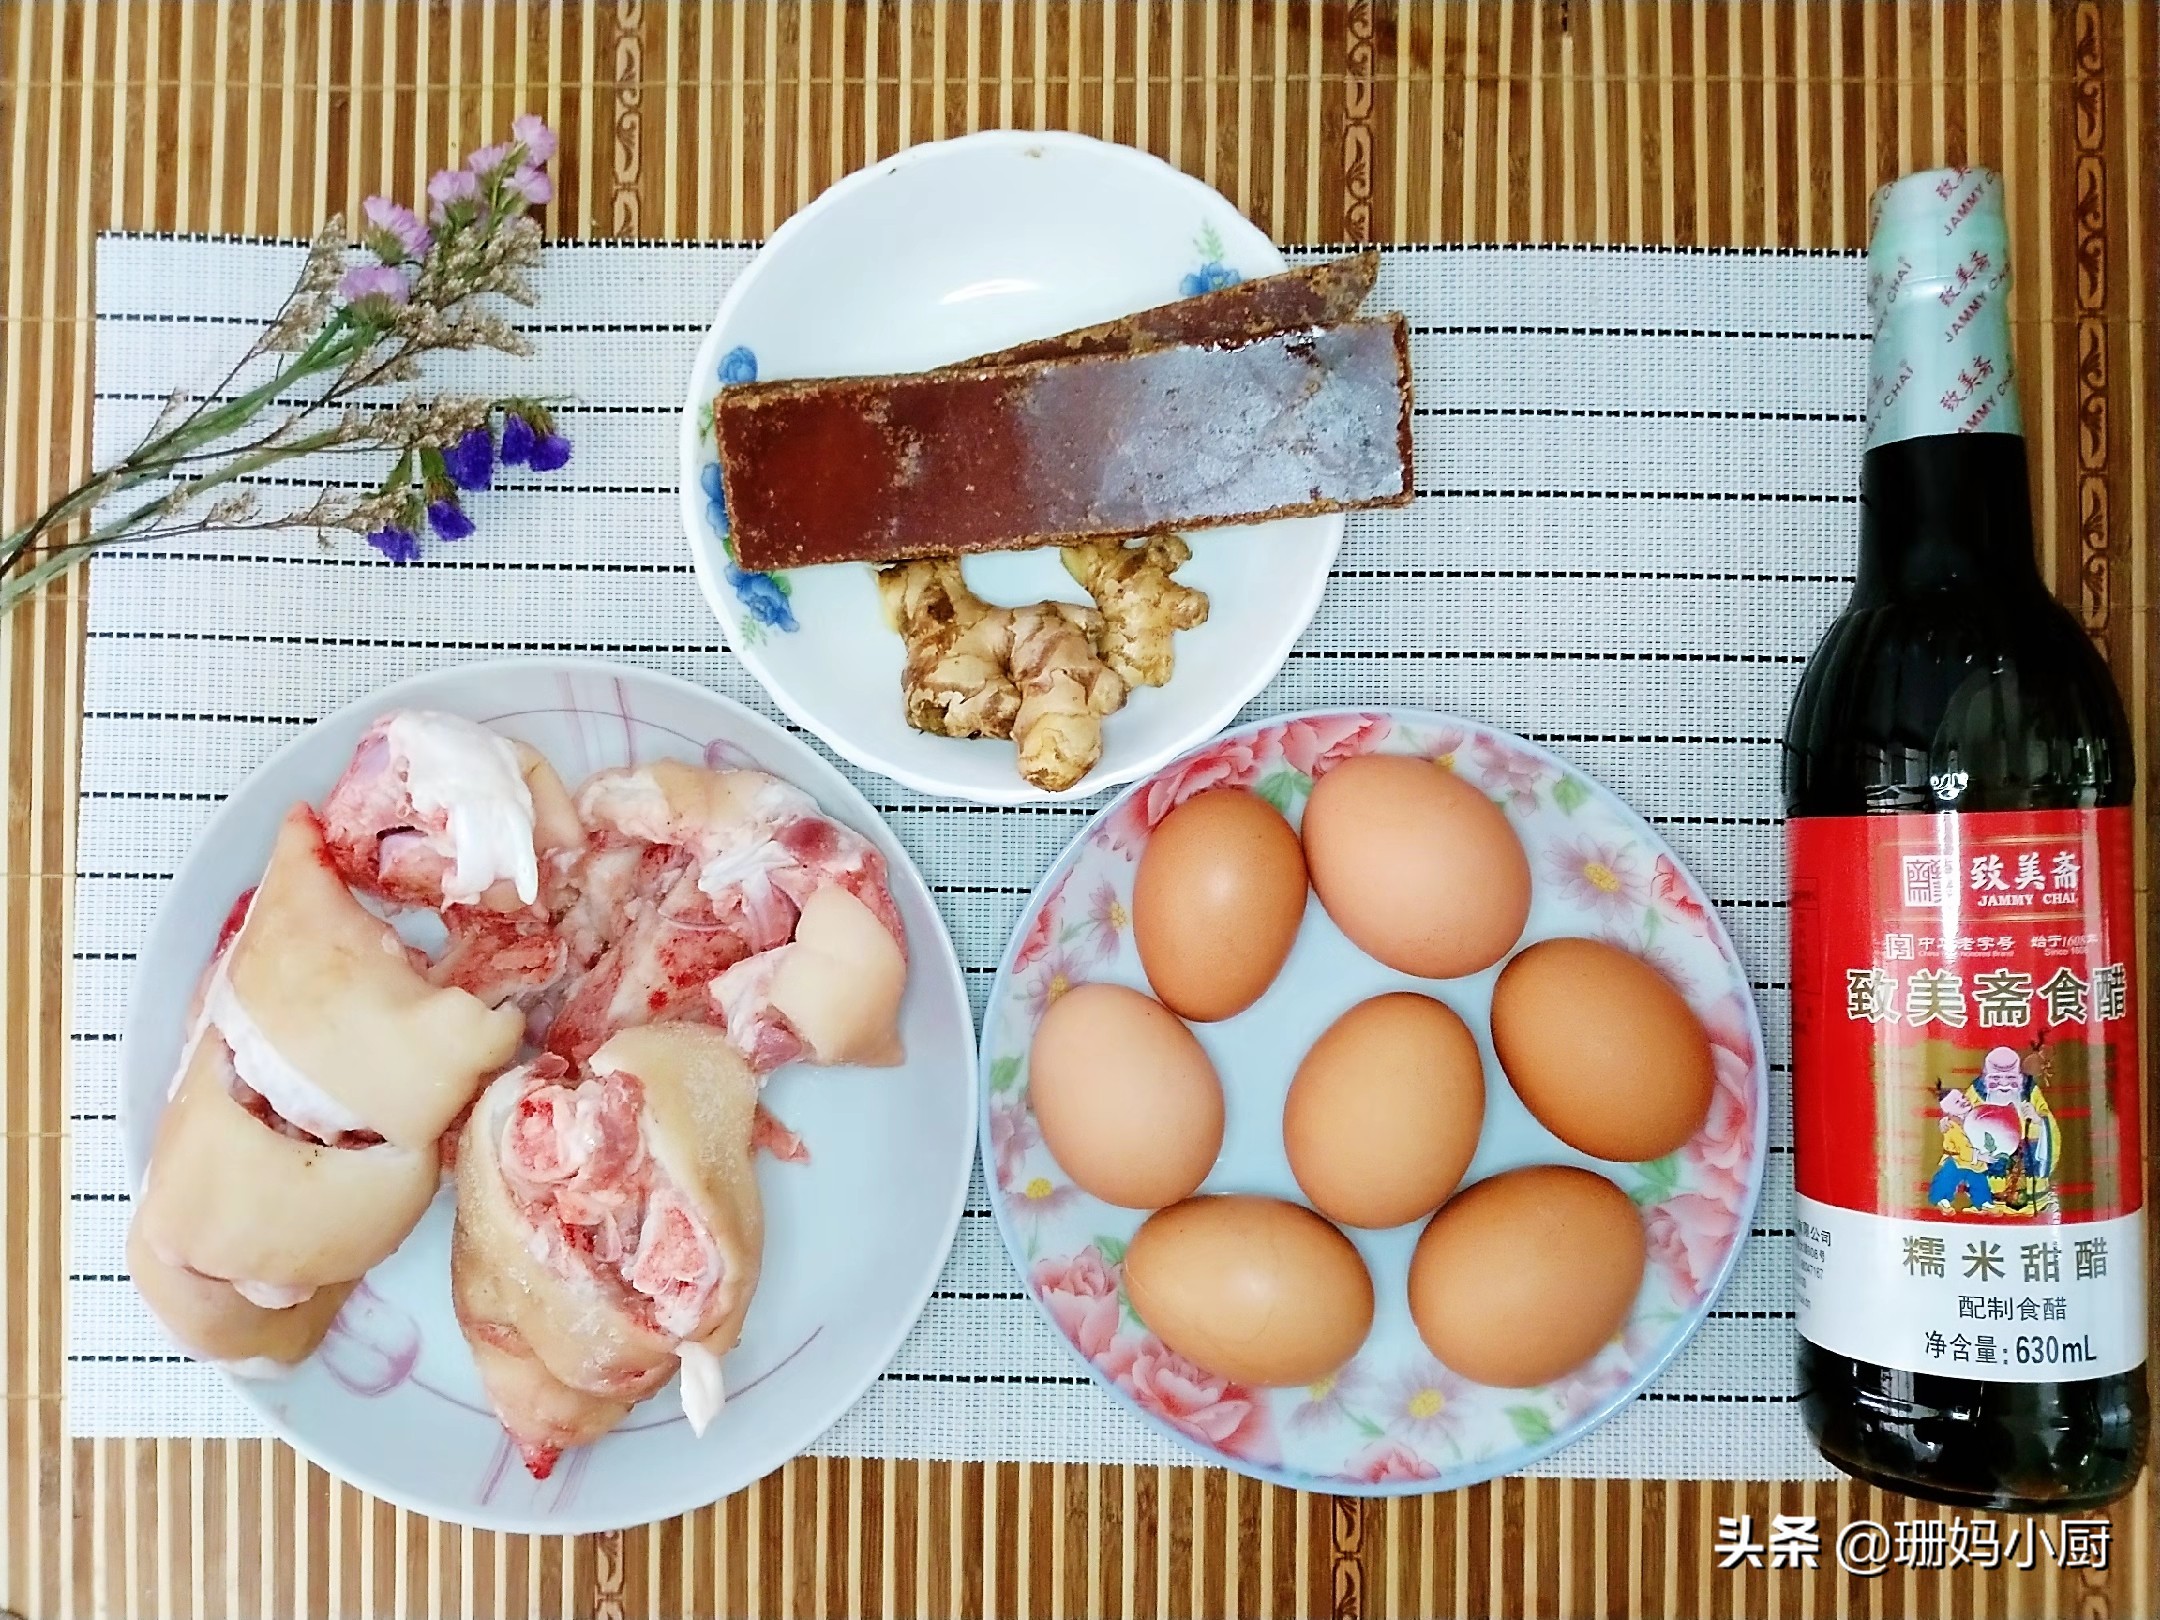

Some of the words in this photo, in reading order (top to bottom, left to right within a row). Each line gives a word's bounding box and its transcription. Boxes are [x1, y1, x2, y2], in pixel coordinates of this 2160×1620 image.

[1944, 183, 1984, 236] JAMMY
[1945, 291, 1987, 343] JAMMY
[1970, 852, 2081, 891] 致美斋
[1977, 894, 2035, 907] JAMMY
[2043, 893, 2079, 905] CHAI
[1846, 963, 2128, 1029] 致美斋食醋
[1903, 1235, 2109, 1283] 糯米甜醋
[1958, 1296, 2067, 1321] 配制食醋
